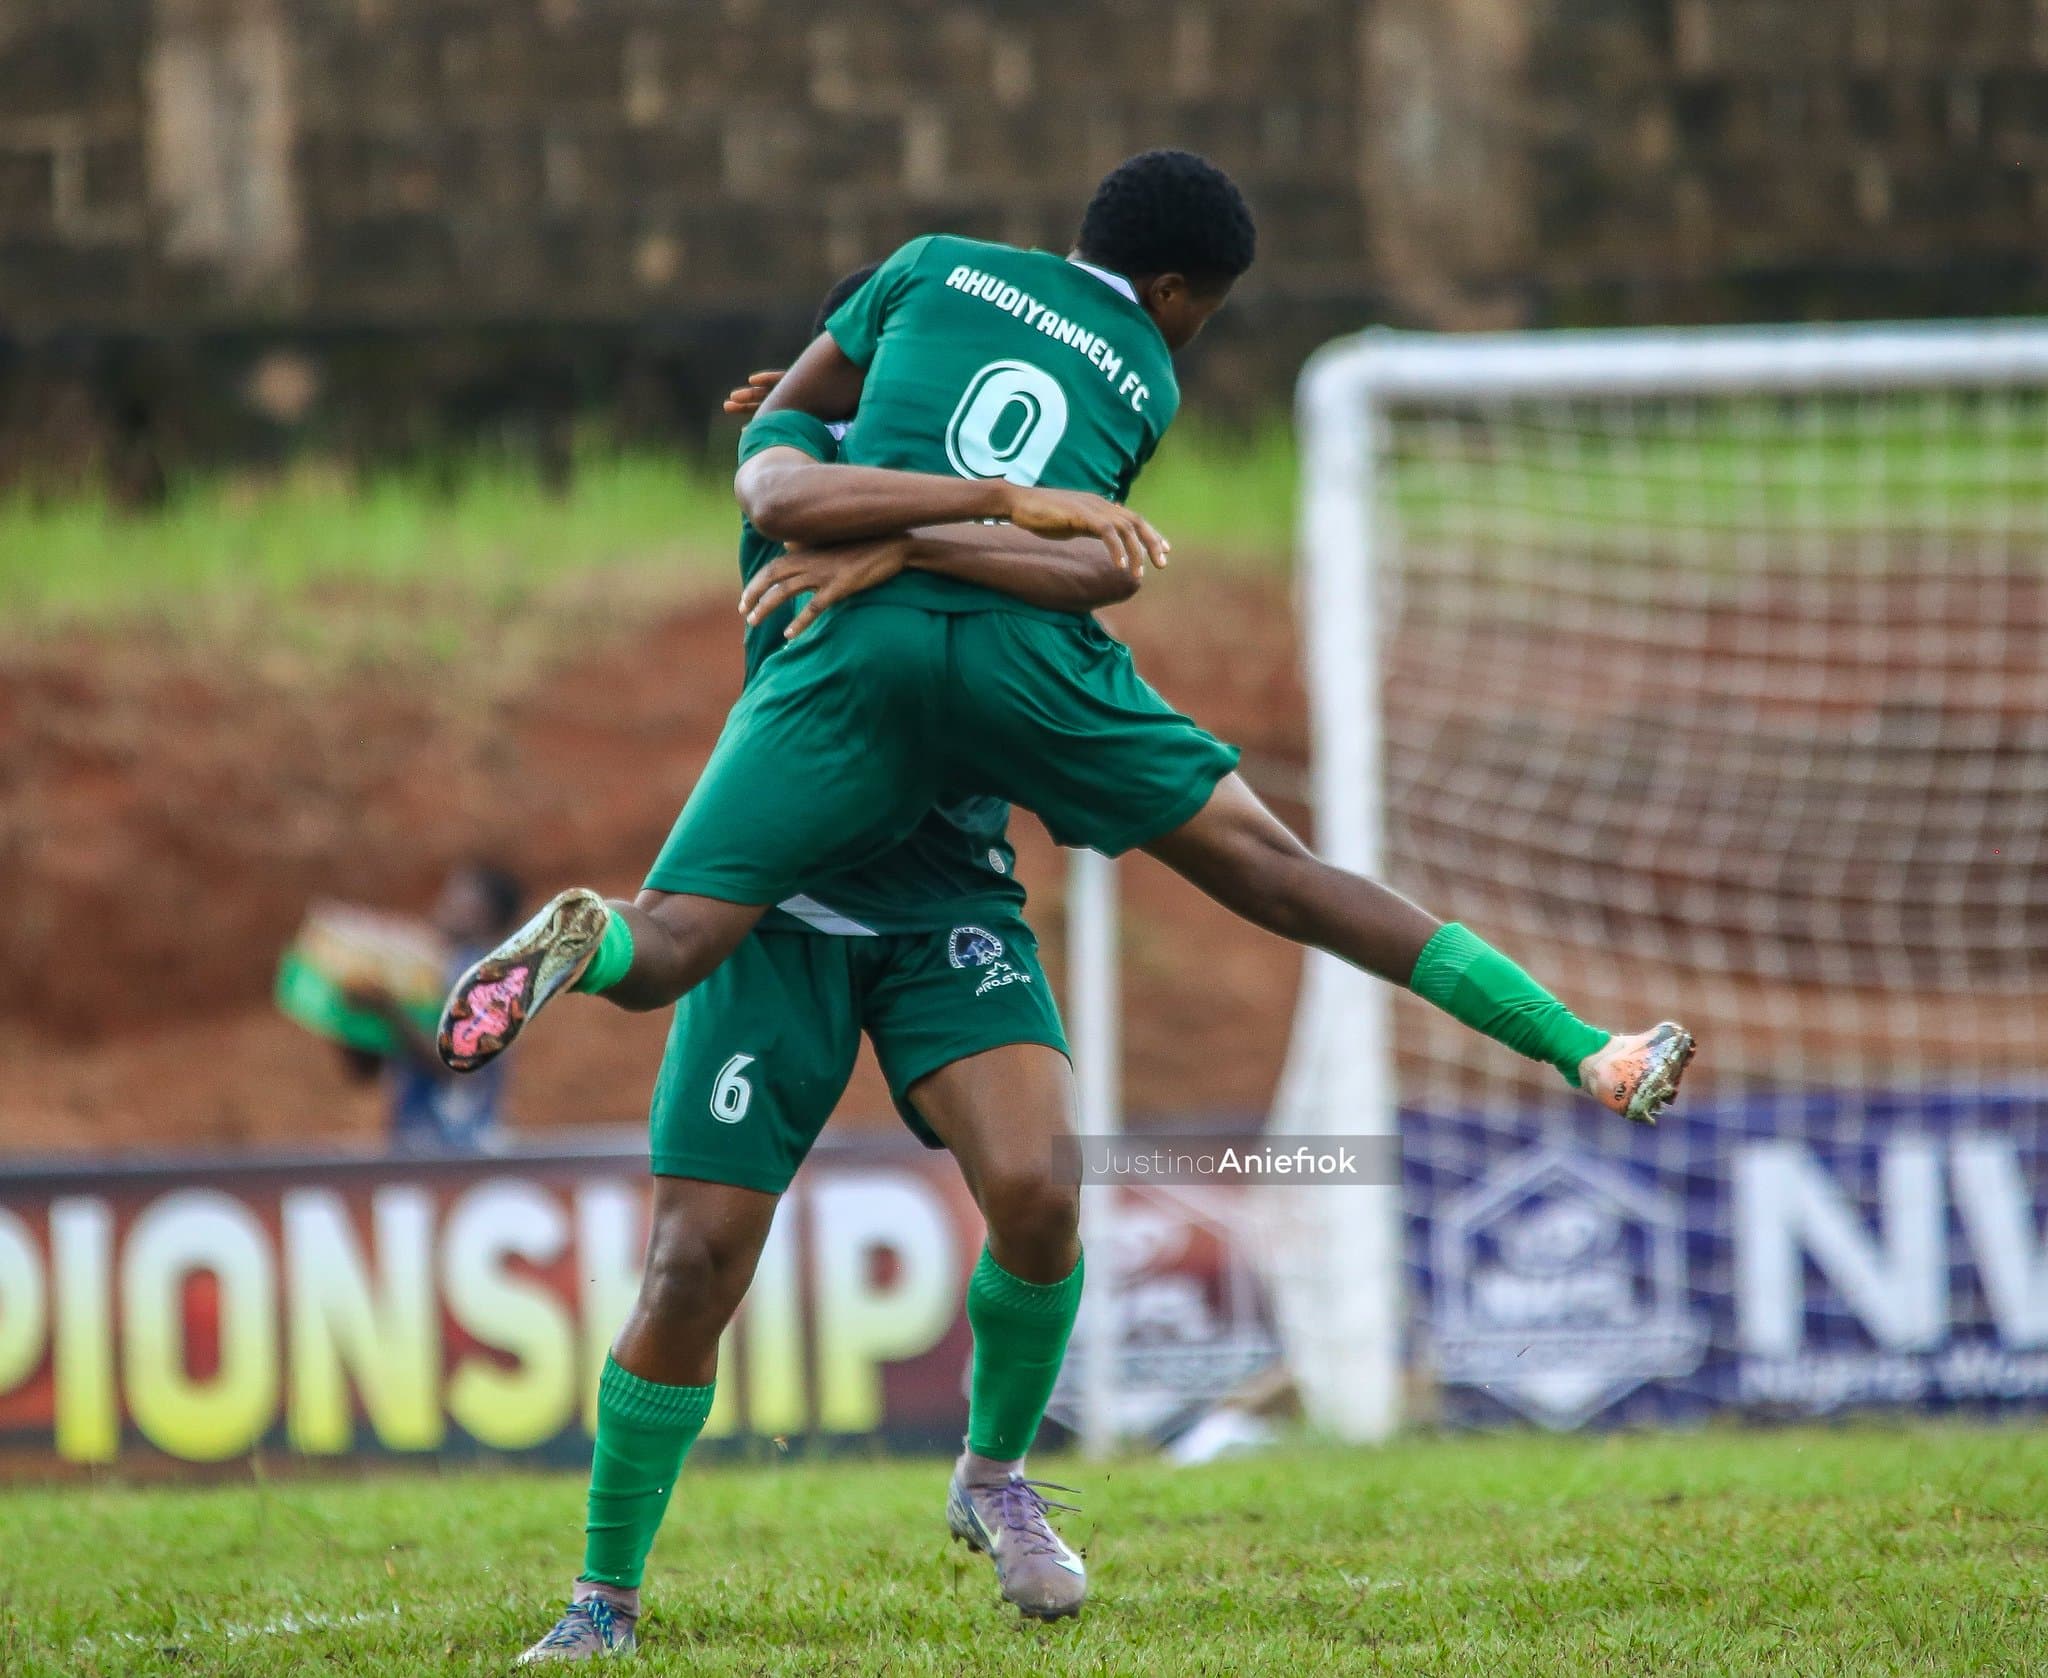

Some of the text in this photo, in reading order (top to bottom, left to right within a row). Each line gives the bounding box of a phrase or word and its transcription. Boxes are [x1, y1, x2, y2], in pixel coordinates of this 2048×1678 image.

[945, 265, 1150, 412] AHUDIYANNEM FC
[945, 358, 1068, 488] 9
[710, 1054, 755, 1124] 6
